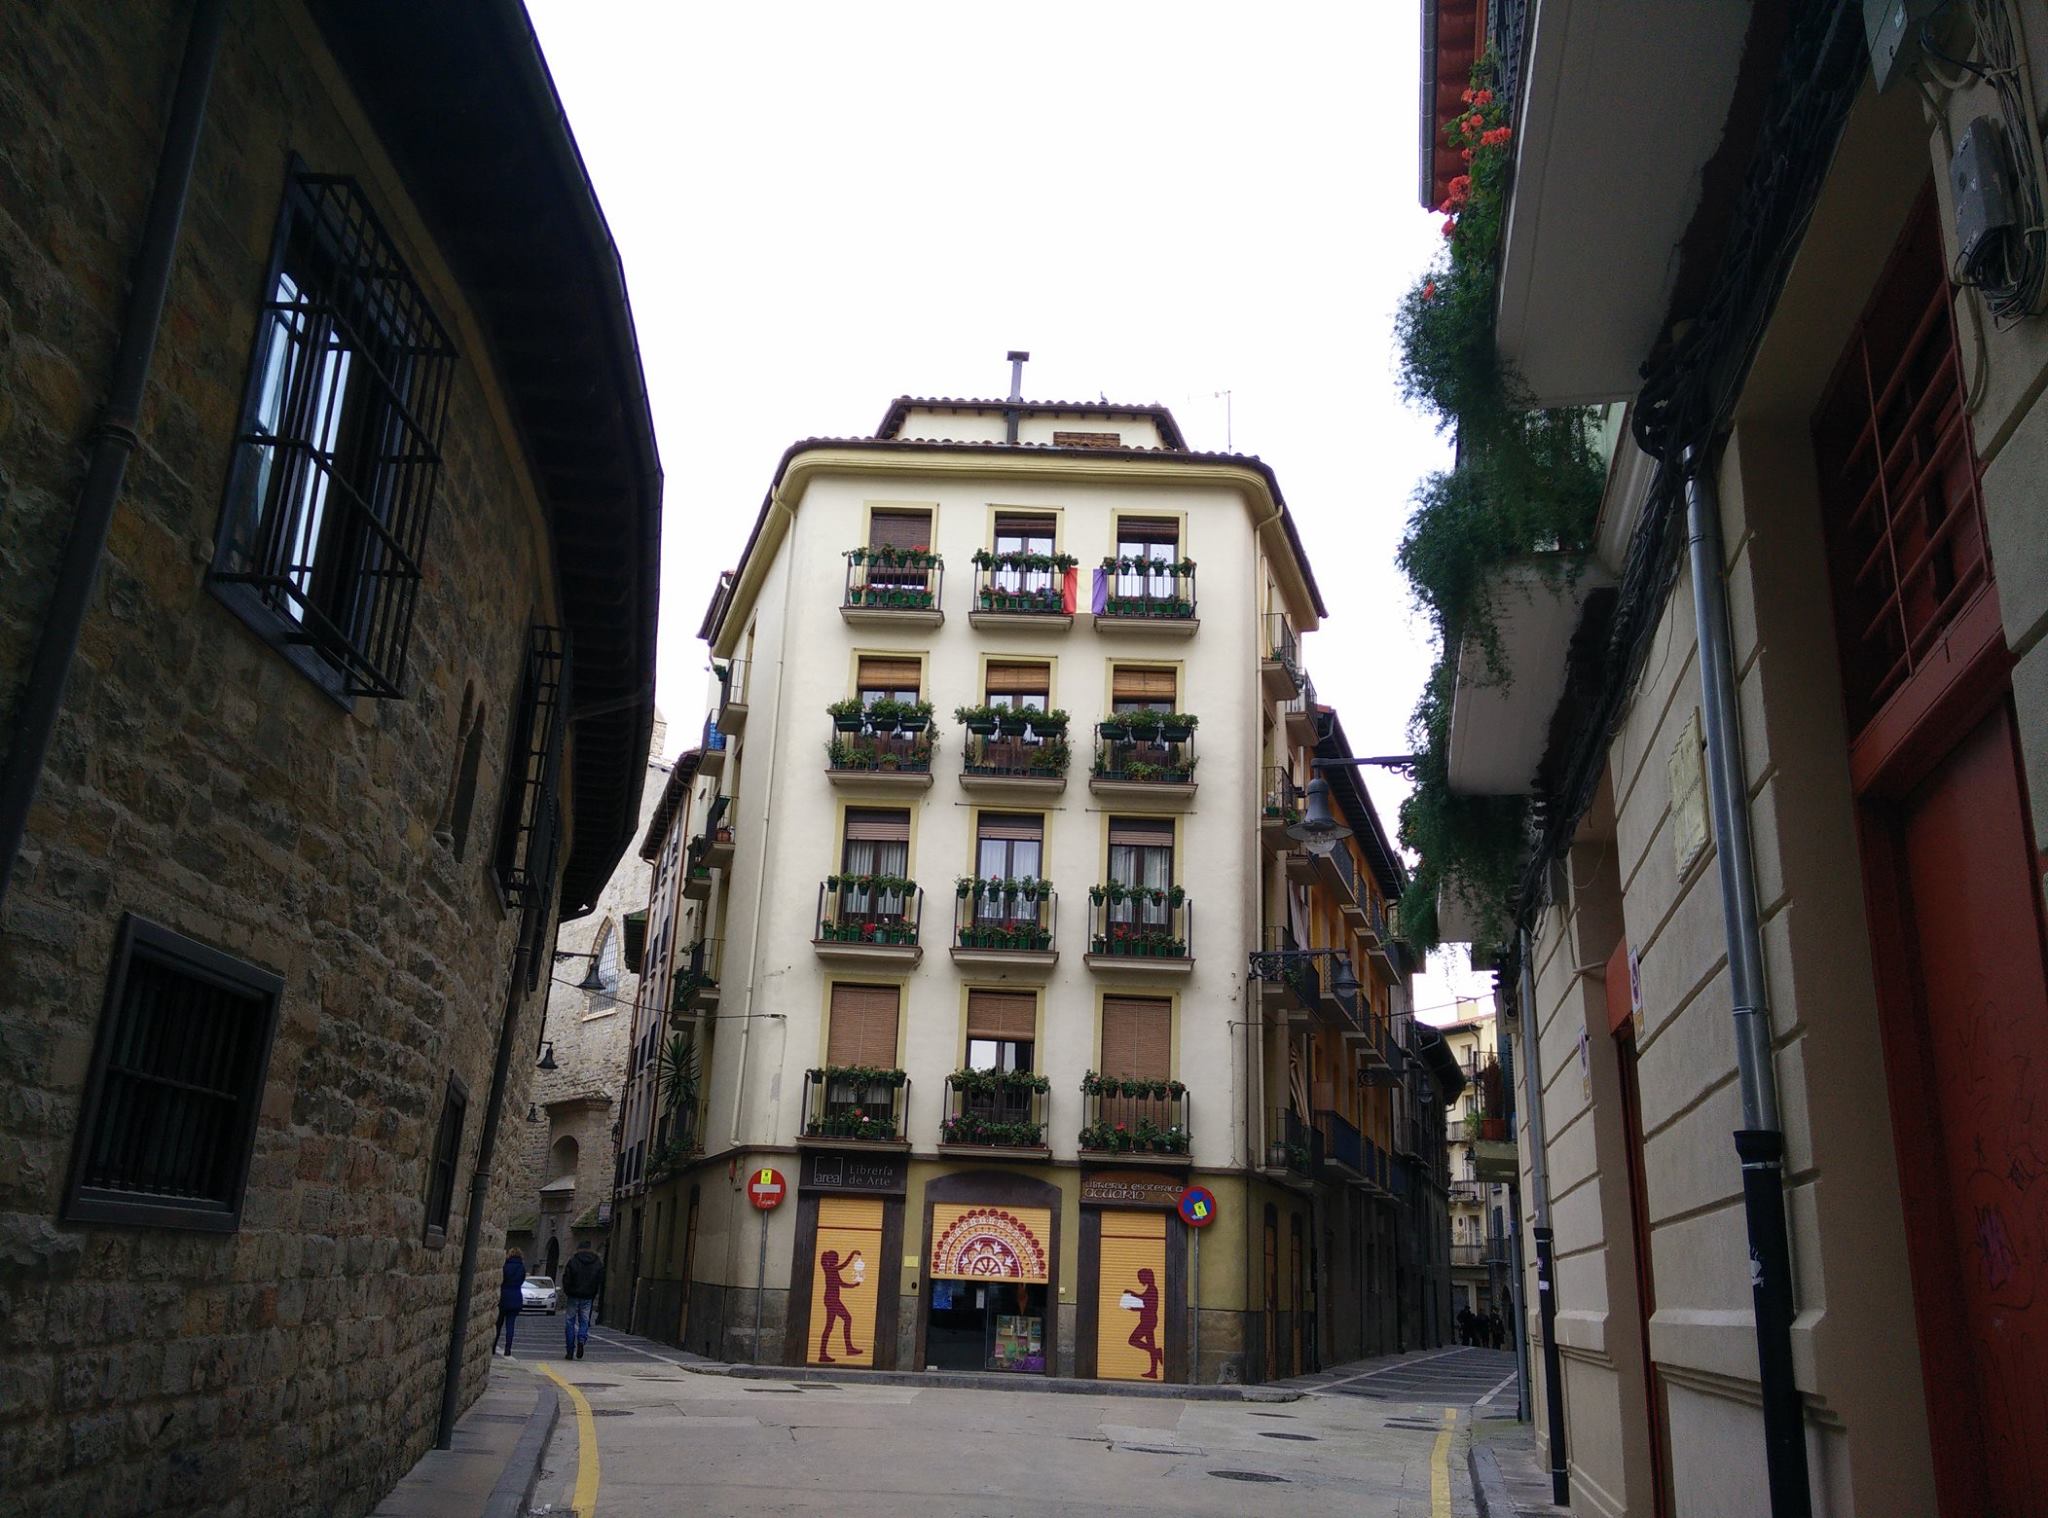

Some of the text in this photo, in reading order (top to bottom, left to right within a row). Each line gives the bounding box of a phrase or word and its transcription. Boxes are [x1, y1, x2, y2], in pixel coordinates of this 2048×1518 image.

[850, 1165, 893, 1176] Librería
[815, 1173, 840, 1184] area
[849, 1176, 891, 1186] de Arte
